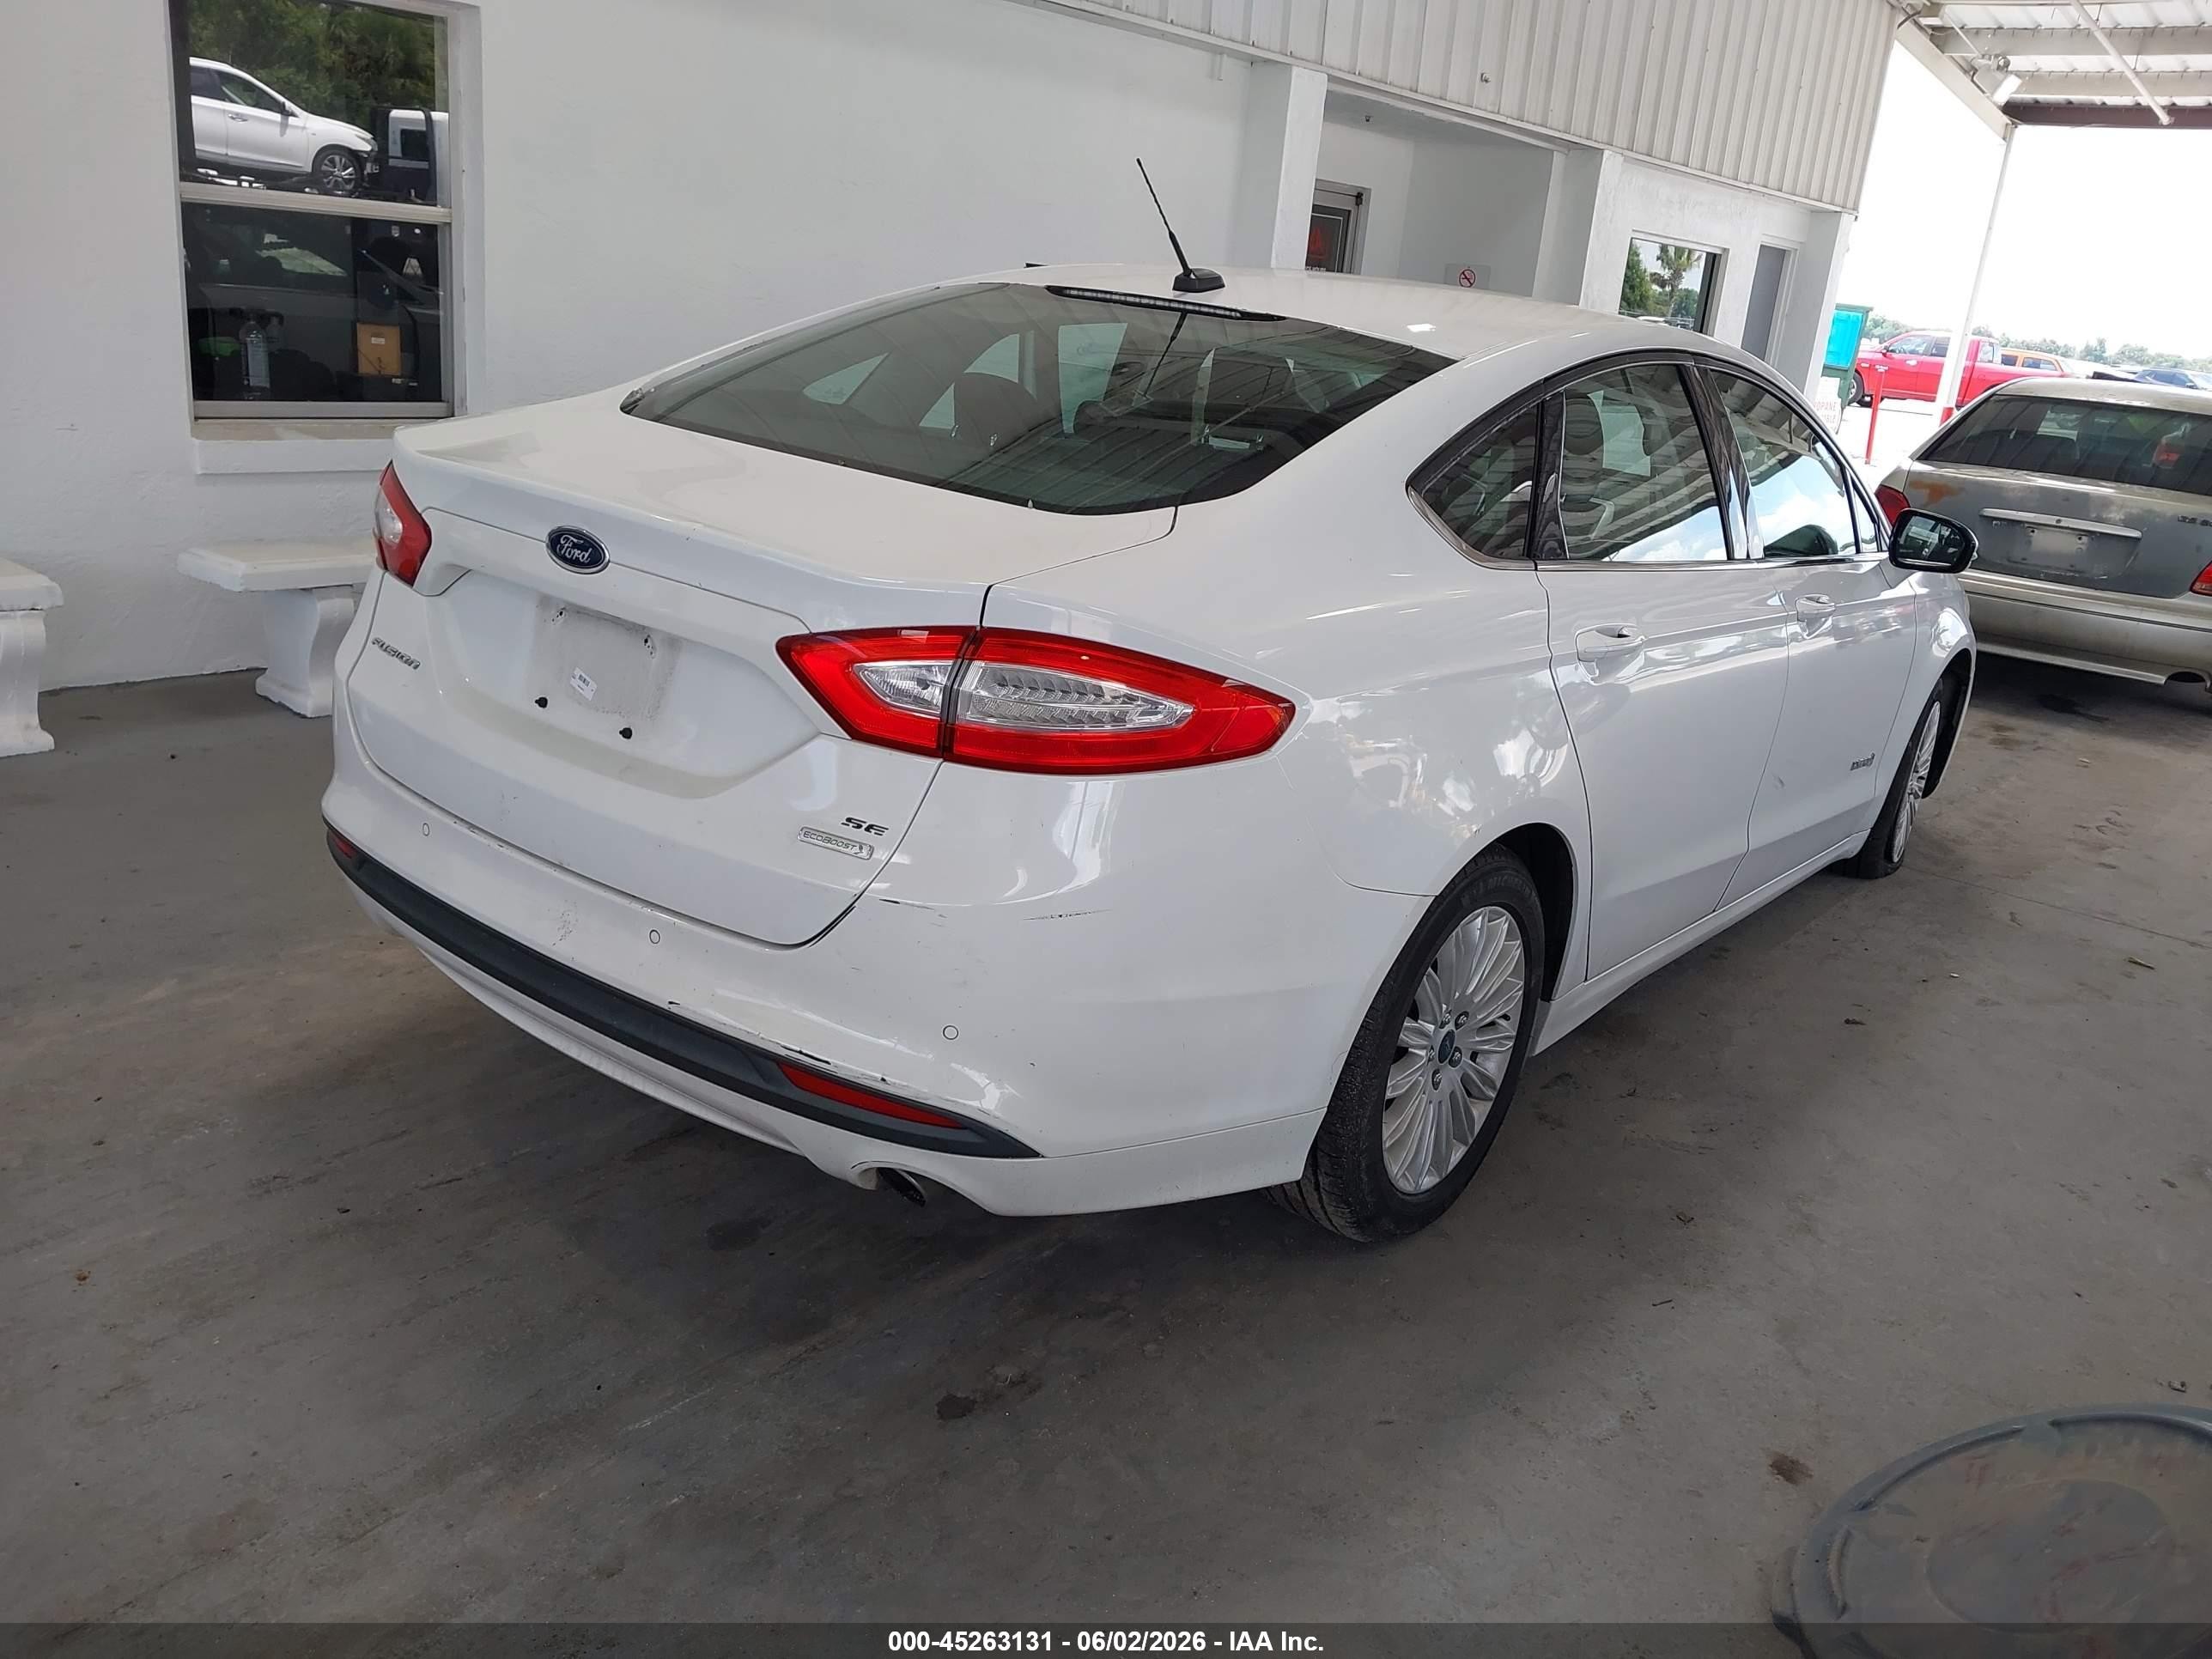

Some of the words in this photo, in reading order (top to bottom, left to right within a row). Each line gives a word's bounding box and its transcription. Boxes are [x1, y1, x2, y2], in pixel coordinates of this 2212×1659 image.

[556, 534, 592, 563] Ford
[372, 637, 421, 670] FUSION
[841, 817, 890, 836] SE
[803, 830, 857, 851] ECOBOOST
